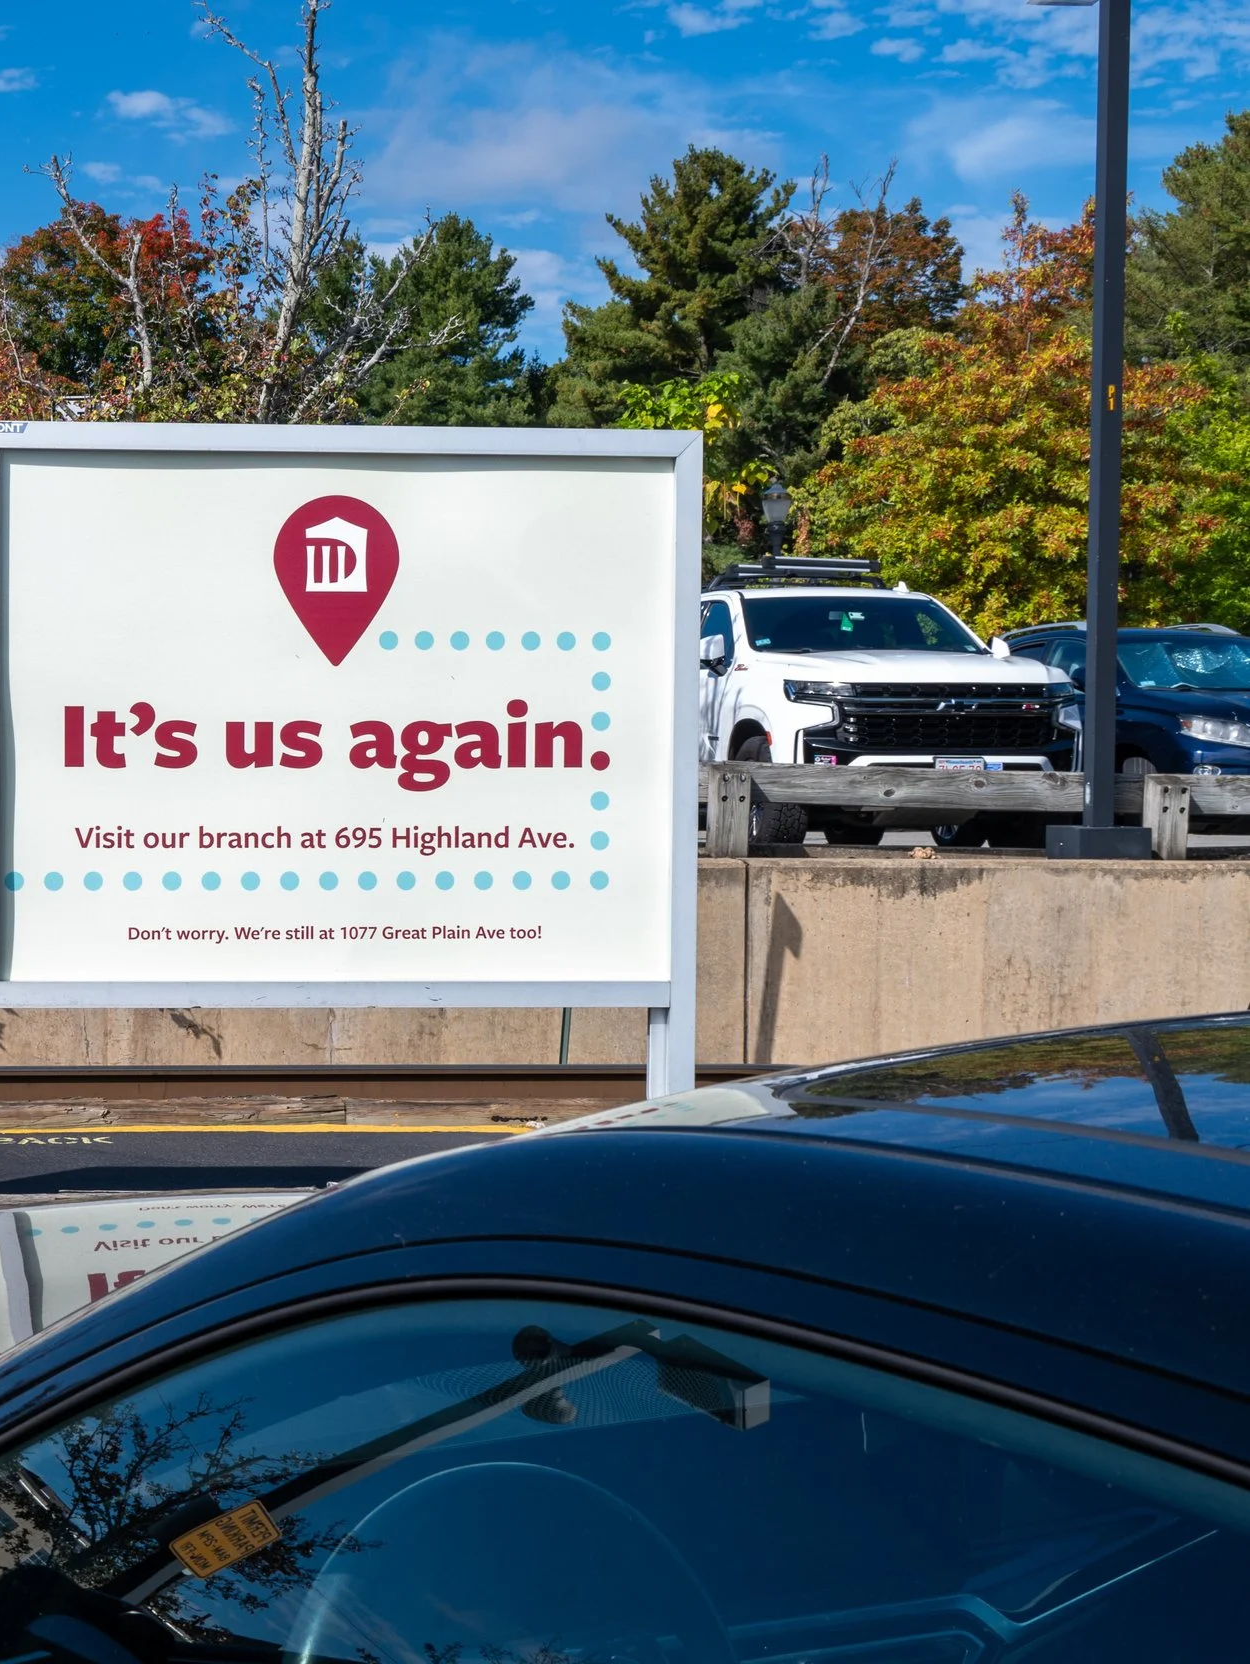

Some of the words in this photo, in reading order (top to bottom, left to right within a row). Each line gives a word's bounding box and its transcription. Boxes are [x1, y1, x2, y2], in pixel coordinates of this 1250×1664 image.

[65, 702, 197, 769] It's
[226, 721, 322, 769] us
[350, 700, 610, 791] again.
[75, 826, 133, 849] Visit
[144, 833, 190, 849] our
[199, 826, 292, 849] branch
[301, 831, 325, 849] at
[335, 828, 382, 849] 695
[392, 826, 510, 856] Highland
[519, 827, 575, 849] Ave.
[128, 927, 172, 940] Don't
[177, 929, 229, 944] worry.
[234, 927, 281, 940] We're
[285, 926, 314, 940] still
[319, 928, 335, 940] at
[340, 926, 378, 940] 1077
[382, 926, 427, 940] Great
[432, 925, 471, 940] Plain
[475, 926, 505, 940] Ave
[509, 926, 542, 940] too!
